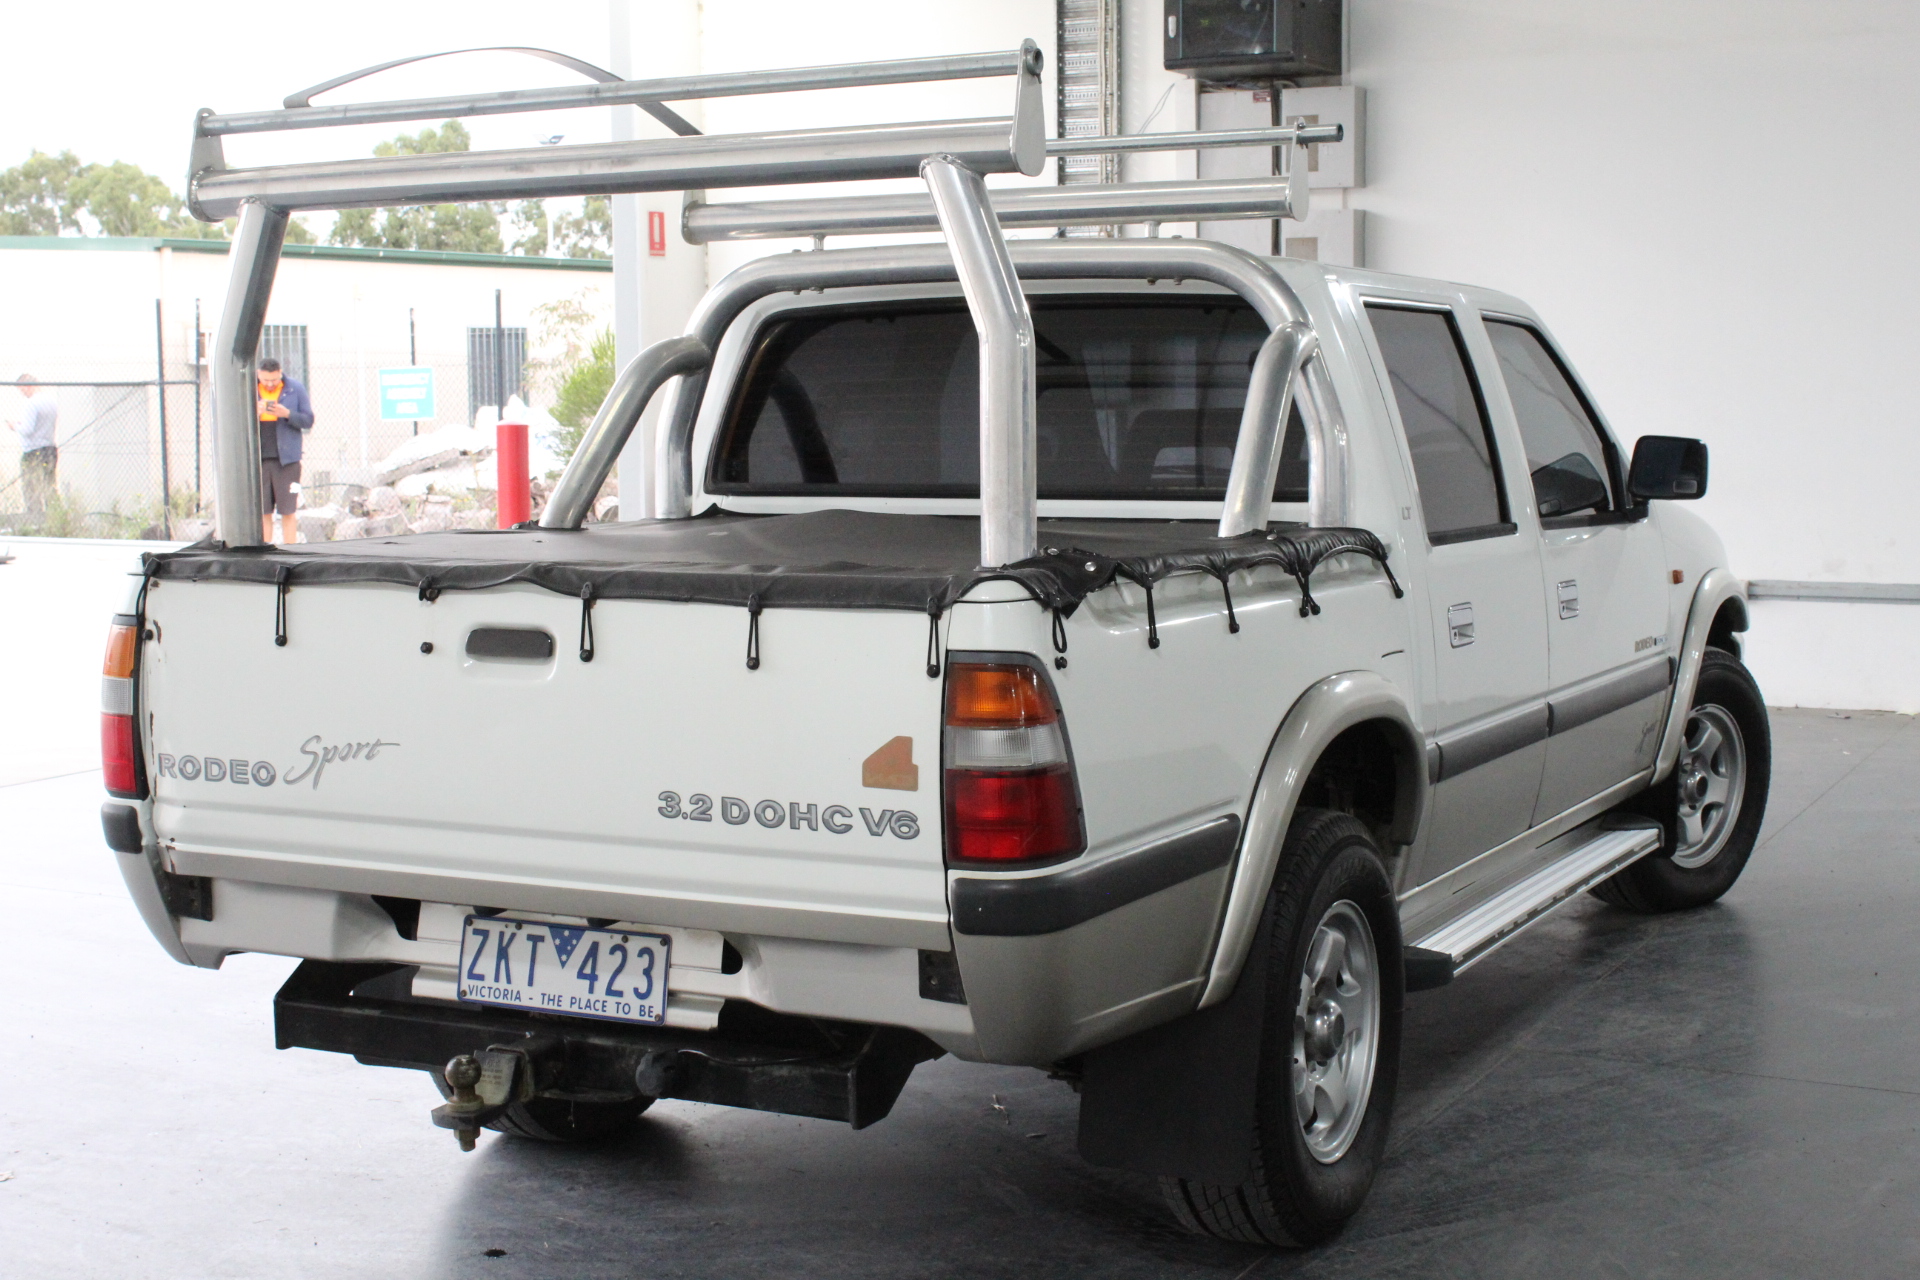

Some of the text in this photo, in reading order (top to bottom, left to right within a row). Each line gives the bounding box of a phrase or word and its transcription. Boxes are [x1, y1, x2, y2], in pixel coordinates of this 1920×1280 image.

[158, 734, 400, 790] RODEO Sport
[658, 790, 713, 822] 3.2
[467, 928, 655, 1000] ZKT 423
[467, 984, 522, 1002] VICTORIA
[541, 992, 563, 1008] THE
[570, 996, 607, 1013] PLACE
[615, 1002, 631, 1015] TO
[639, 1004, 654, 1018] BE
